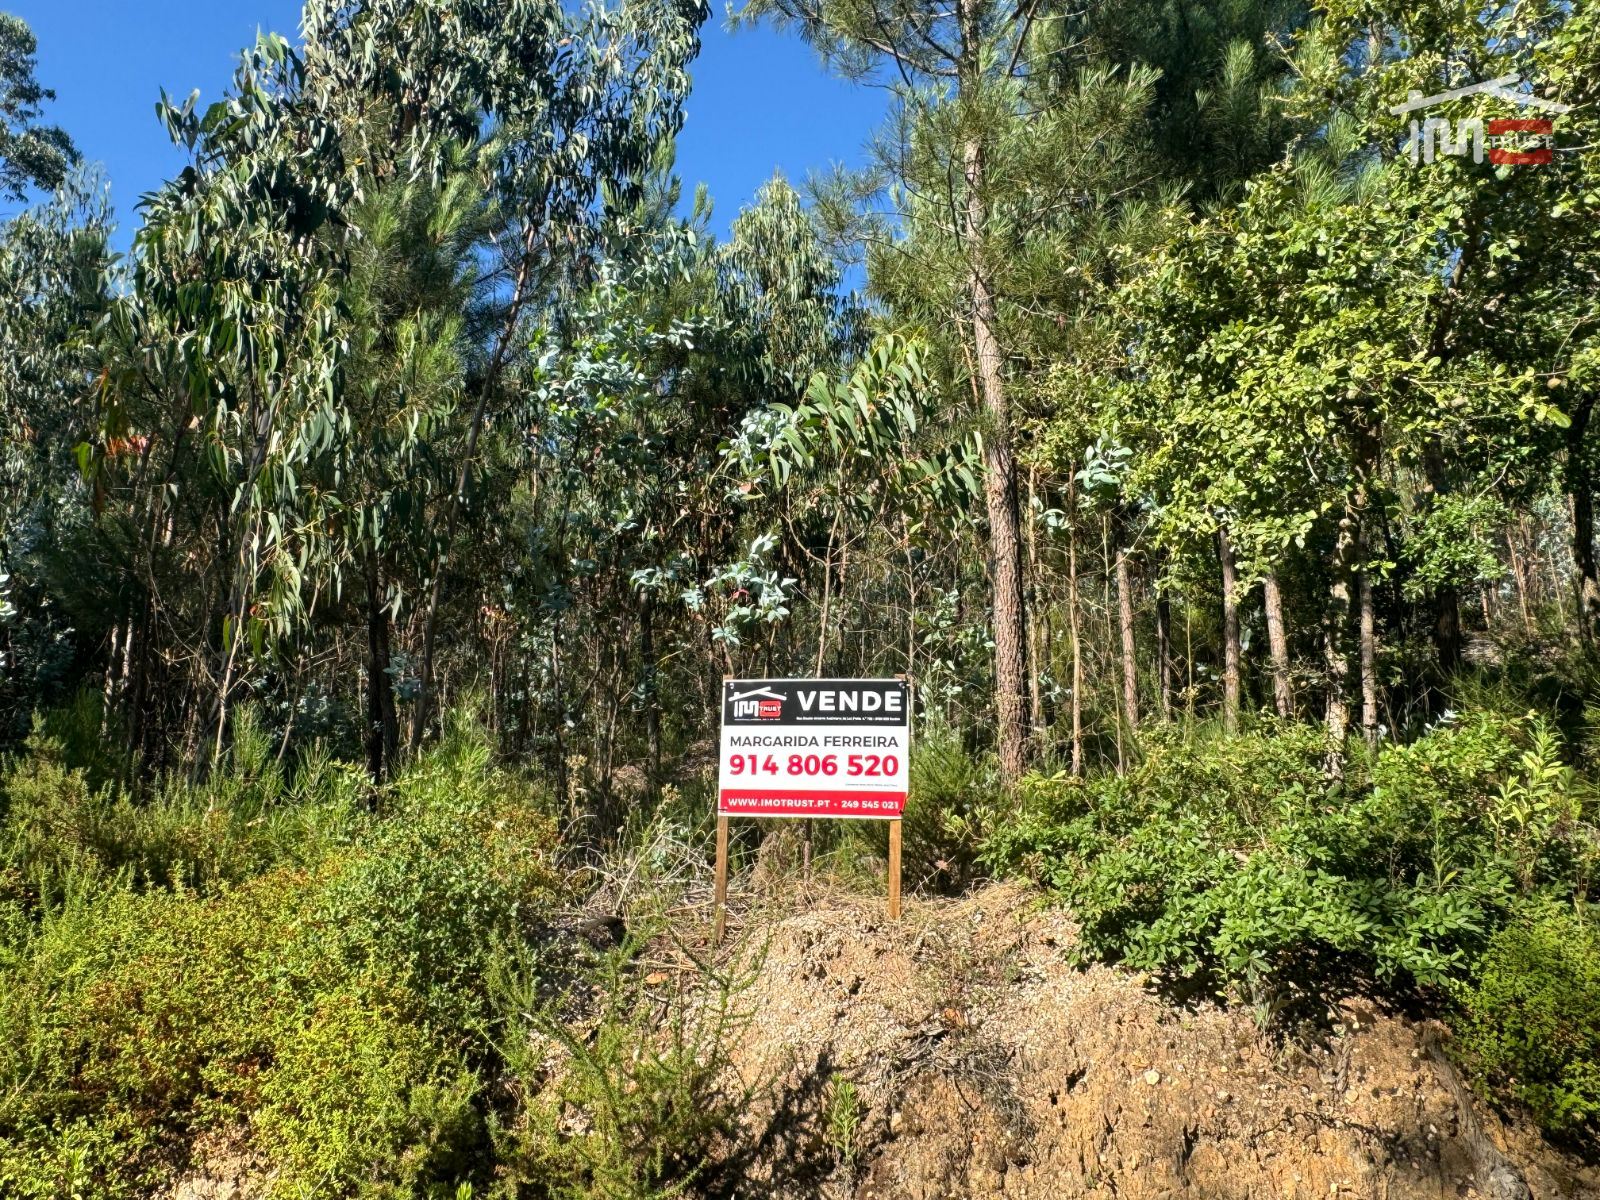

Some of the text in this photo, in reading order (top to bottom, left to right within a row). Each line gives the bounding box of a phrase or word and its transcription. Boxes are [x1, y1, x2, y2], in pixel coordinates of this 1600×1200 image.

[796, 690, 902, 712] VENDE
[730, 735, 899, 748] MARGARIDA FERREIRA
[729, 754, 899, 777] 914 806 520
[728, 798, 899, 810] WWW.IMOTRUST.PT 249 545 021
